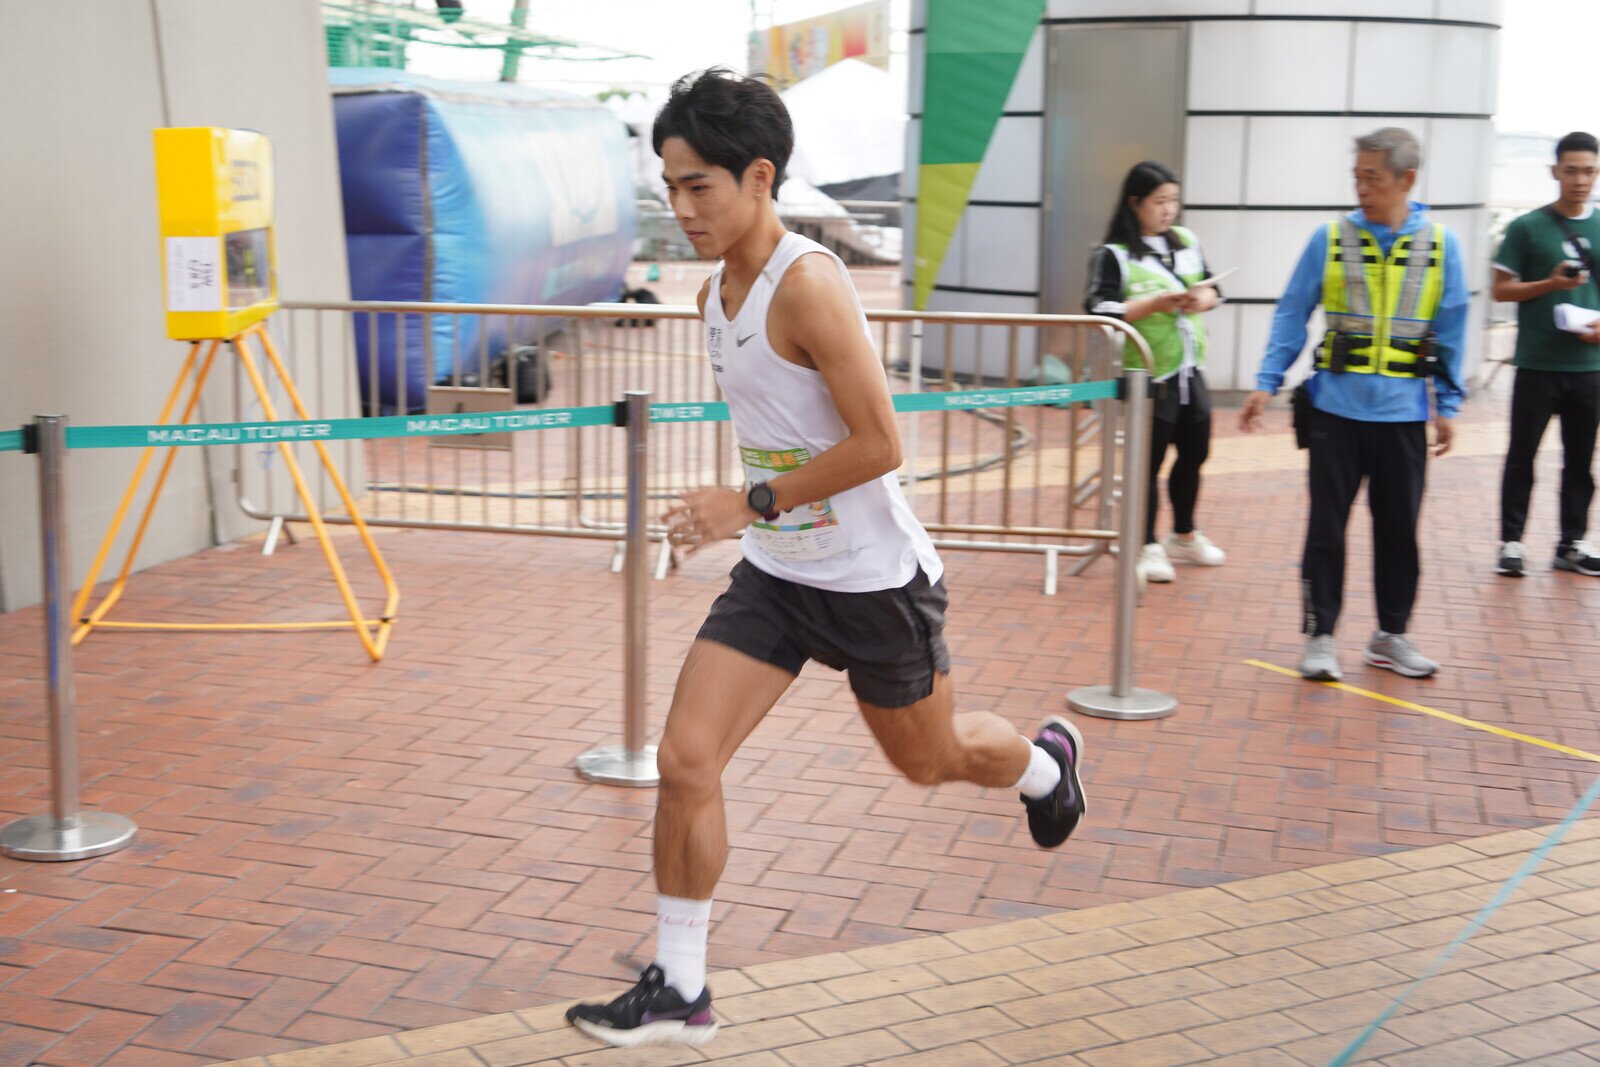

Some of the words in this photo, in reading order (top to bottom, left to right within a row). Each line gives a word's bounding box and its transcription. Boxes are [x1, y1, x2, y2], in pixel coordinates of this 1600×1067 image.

[1009, 388, 1072, 402] TOWER
[648, 406, 704, 419] OWER
[407, 418, 490, 432] MACAU
[492, 412, 572, 428] TOWER
[147, 427, 240, 442] MACAU
[242, 424, 332, 440] TOWER
